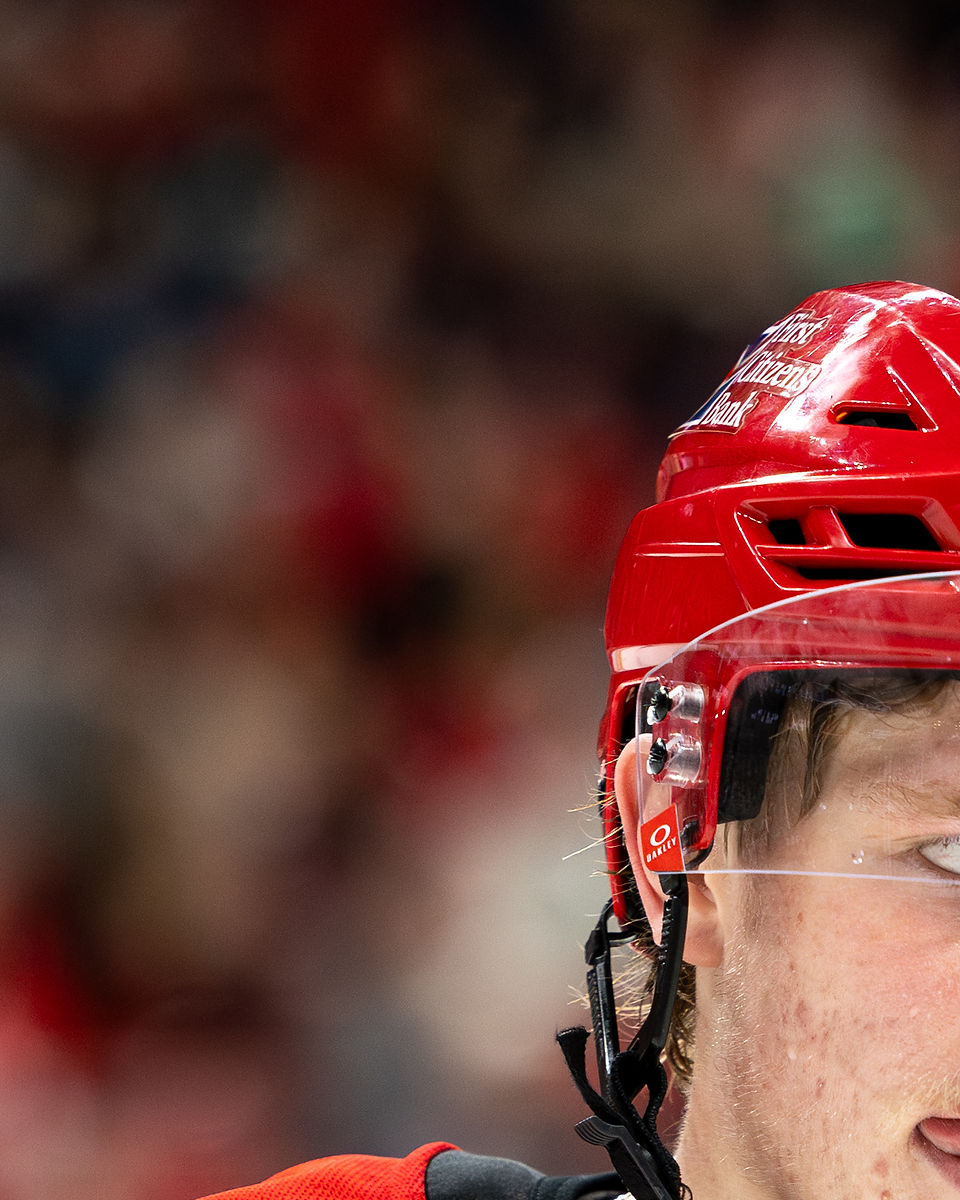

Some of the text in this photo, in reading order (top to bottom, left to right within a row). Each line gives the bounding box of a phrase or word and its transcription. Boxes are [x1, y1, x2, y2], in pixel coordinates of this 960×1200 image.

[770, 312, 830, 345] First
[737, 350, 816, 394] Citizens
[703, 391, 756, 427] Bank
[646, 836, 677, 863] OAKLEY
